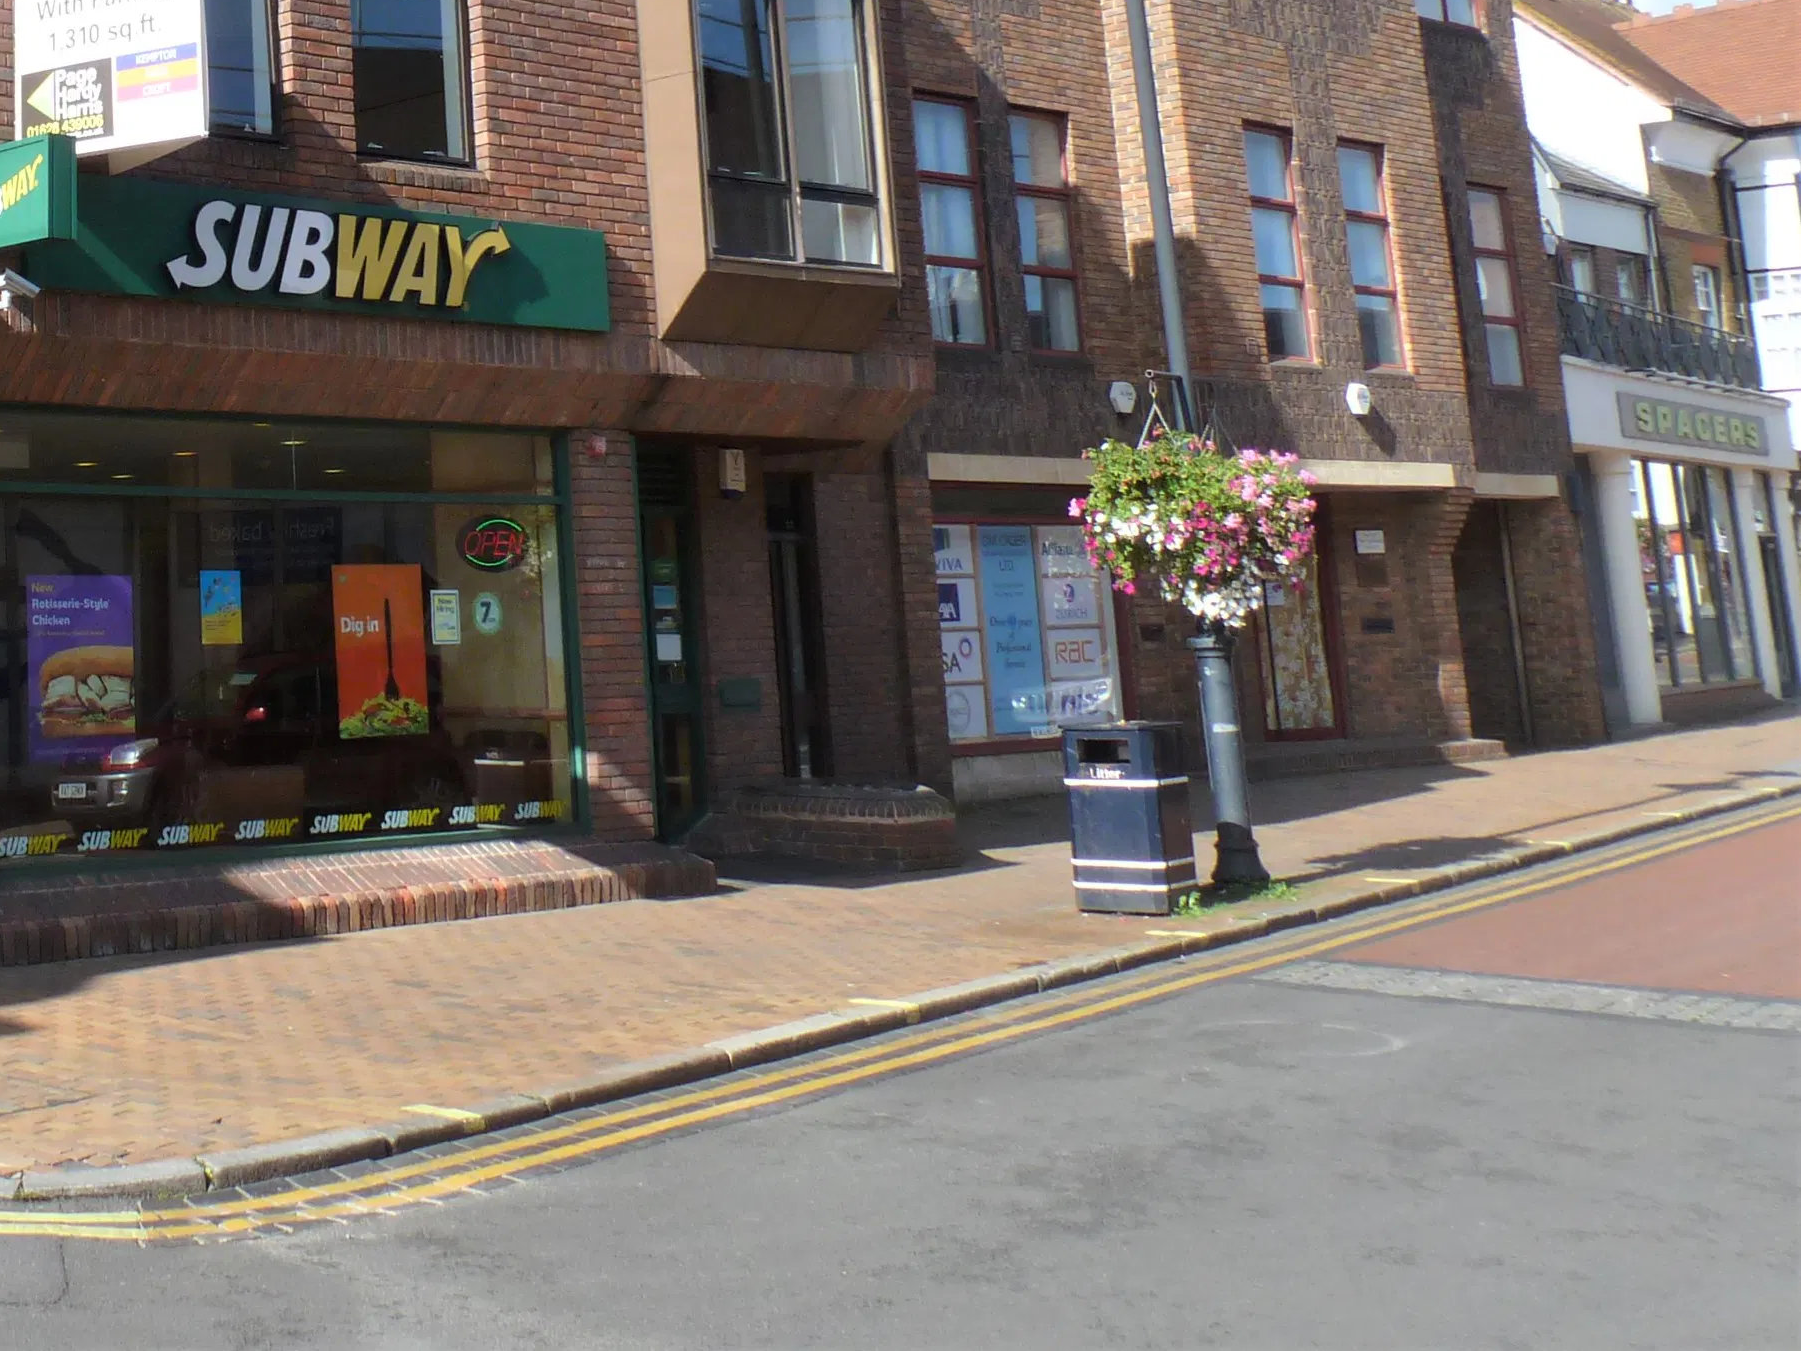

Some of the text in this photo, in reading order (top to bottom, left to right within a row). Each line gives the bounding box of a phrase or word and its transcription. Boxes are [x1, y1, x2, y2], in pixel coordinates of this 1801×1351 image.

[57, 67, 97, 87] Page
[58, 83, 102, 105] Hardy
[166, 200, 511, 308] SUBWAY
[464, 531, 525, 556] OPEN
[31, 582, 55, 593] New
[32, 614, 71, 626] Chicken
[480, 600, 492, 624] 7
[341, 616, 379, 637] Dig in
[942, 652, 962, 674] SA
[1088, 767, 1123, 779] Litter
[78, 827, 148, 851] SUBWAY
[158, 822, 224, 846] SUBWAY
[235, 817, 299, 839] SUBWAY
[310, 812, 372, 834] SUBWAY
[381, 807, 441, 829] SUBWAY
[449, 803, 506, 824] SUBWAY
[515, 800, 568, 819] SUBWAY
